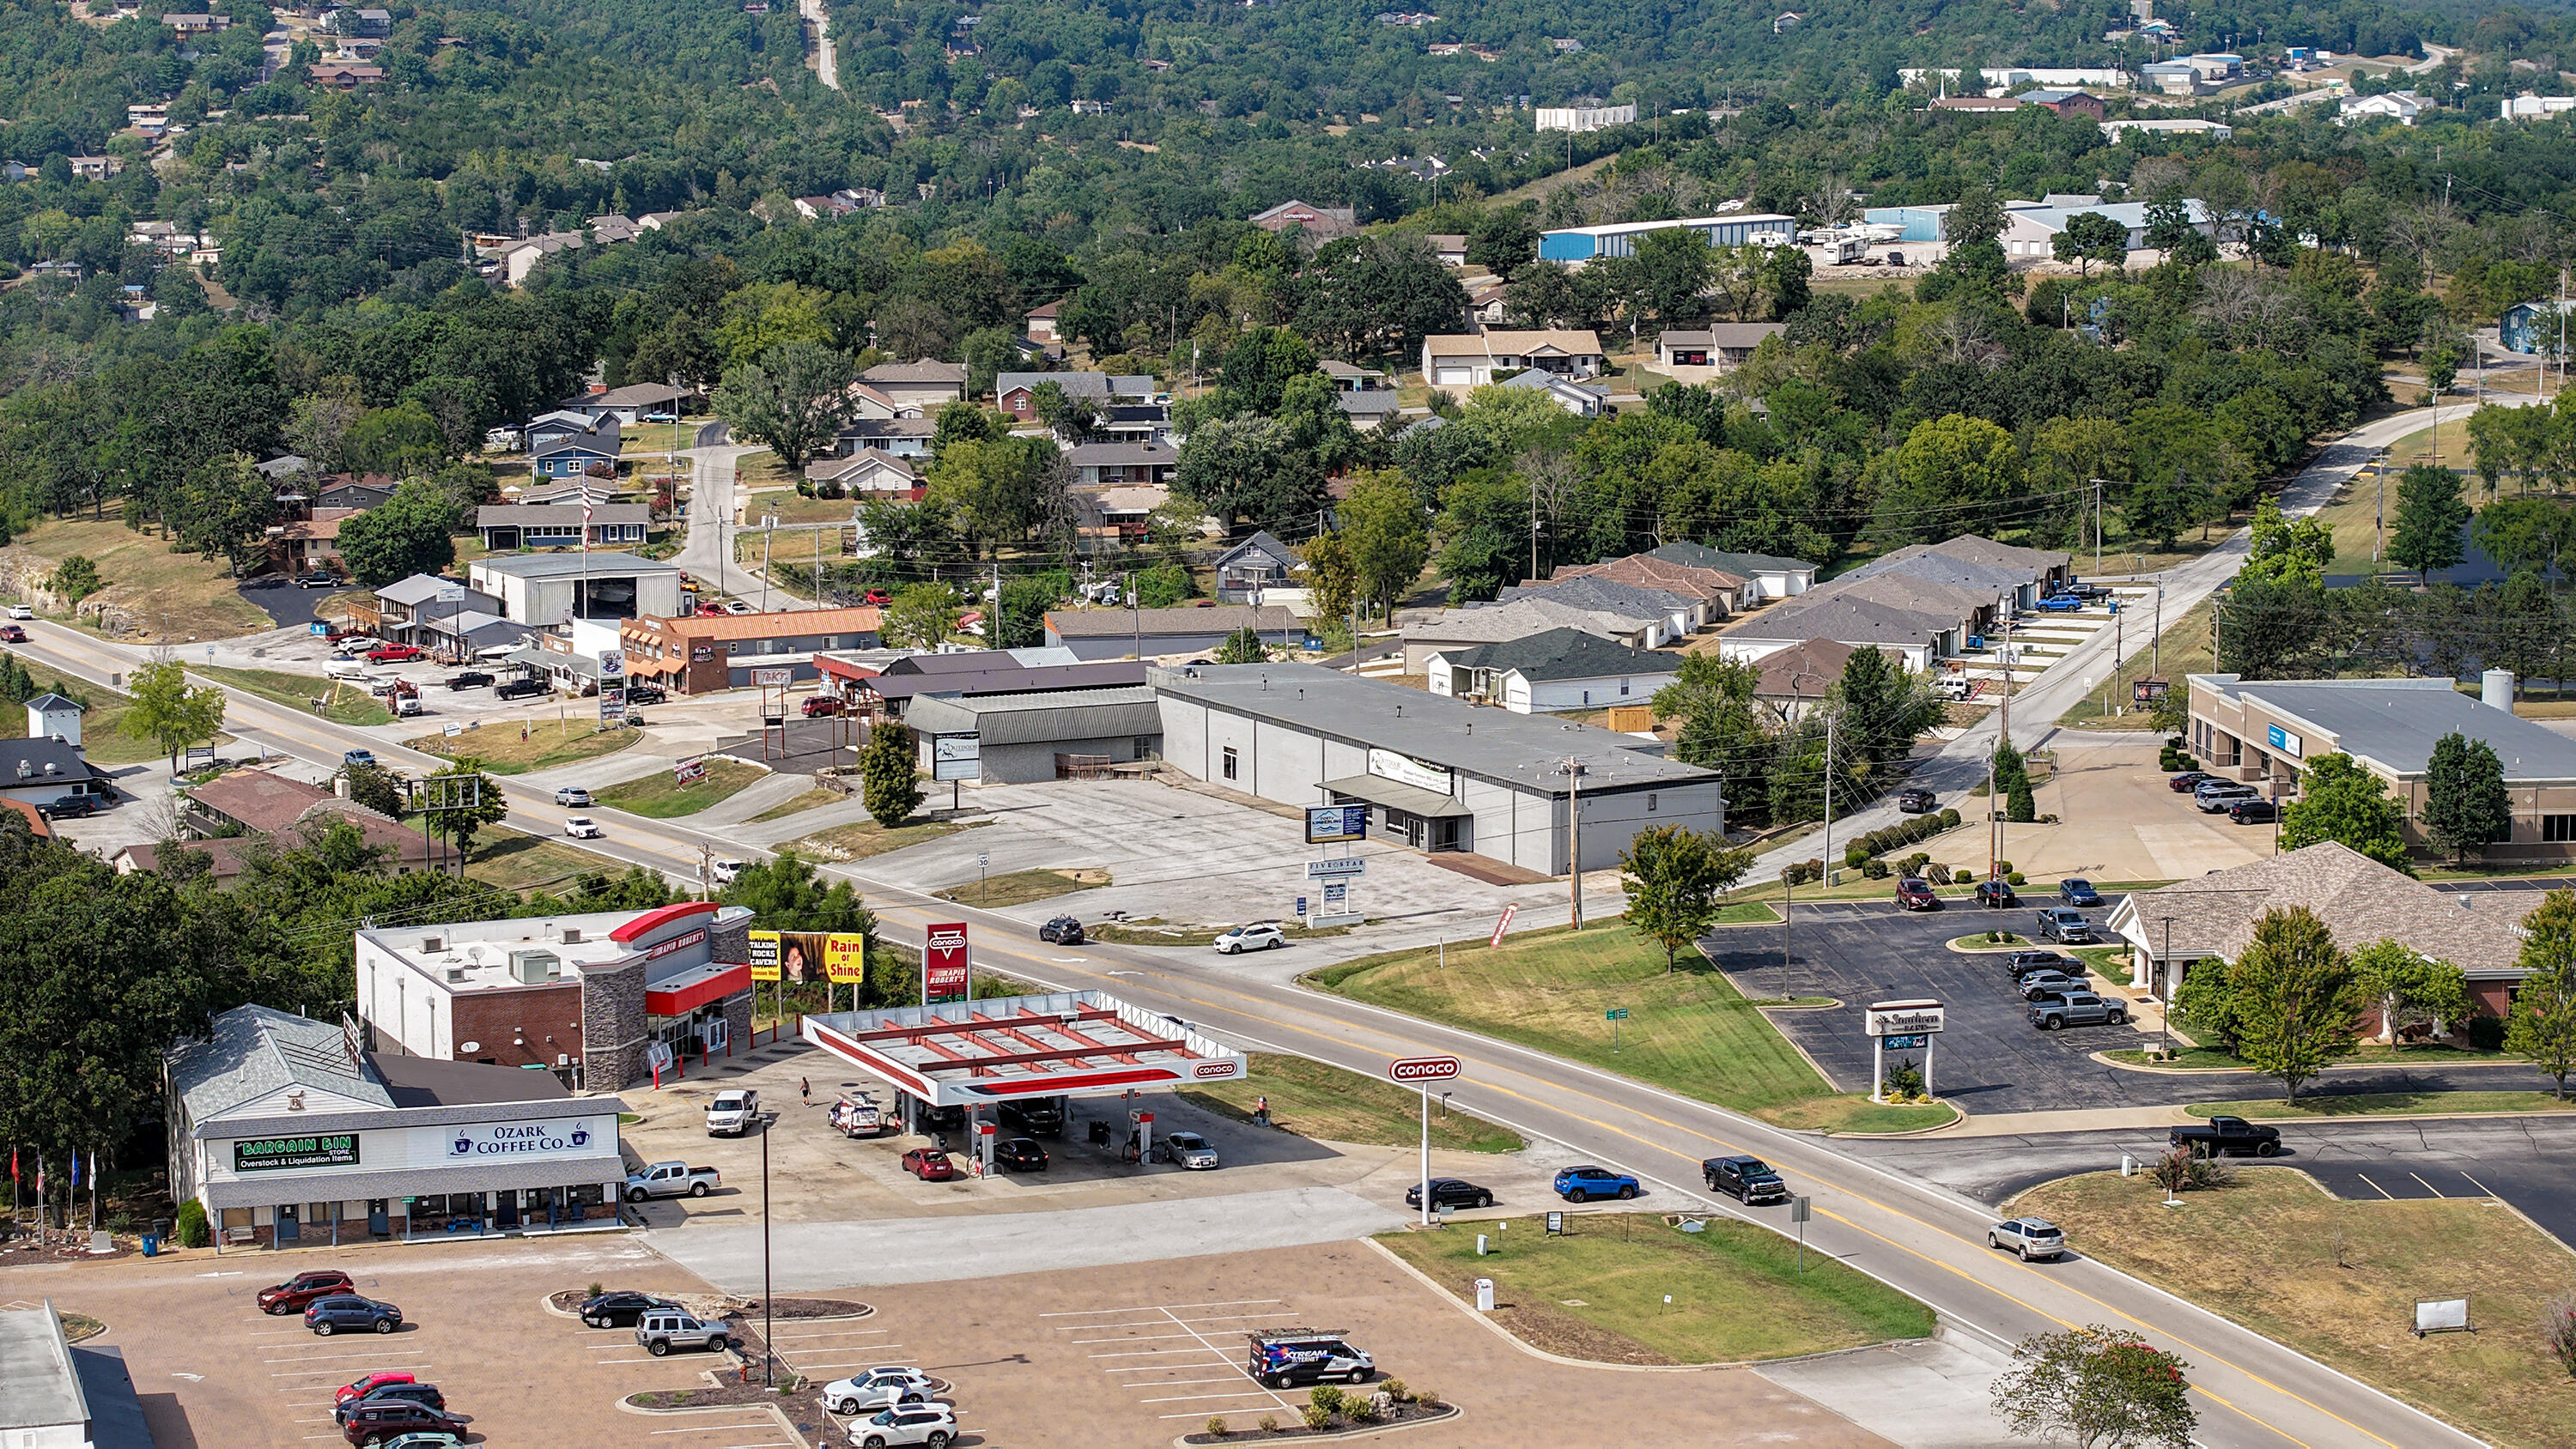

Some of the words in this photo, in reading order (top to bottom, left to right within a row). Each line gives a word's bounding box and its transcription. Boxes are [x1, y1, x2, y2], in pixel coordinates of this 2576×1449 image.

[659, 940, 677, 955] RAPID
[677, 929, 705, 949] ROBERT'S
[750, 941, 778, 949] TALKING
[830, 939, 860, 954] Rain
[750, 958, 778, 967] CAVERN
[841, 954, 850, 962] or
[830, 963, 860, 977] Shine
[943, 968, 966, 977] RAPID
[929, 975, 965, 985] ROBERT'S
[1891, 1012, 1940, 1025] Southern
[494, 1125, 546, 1139] OZARK
[242, 1138, 317, 1156] BARGAIN
[322, 1136, 352, 1150] BIN
[477, 1140, 536, 1155] COFFEE
[240, 1157, 279, 1168] Overstock
[288, 1155, 331, 1167] Liquidation
[1283, 1349, 1328, 1359] XTREAM
